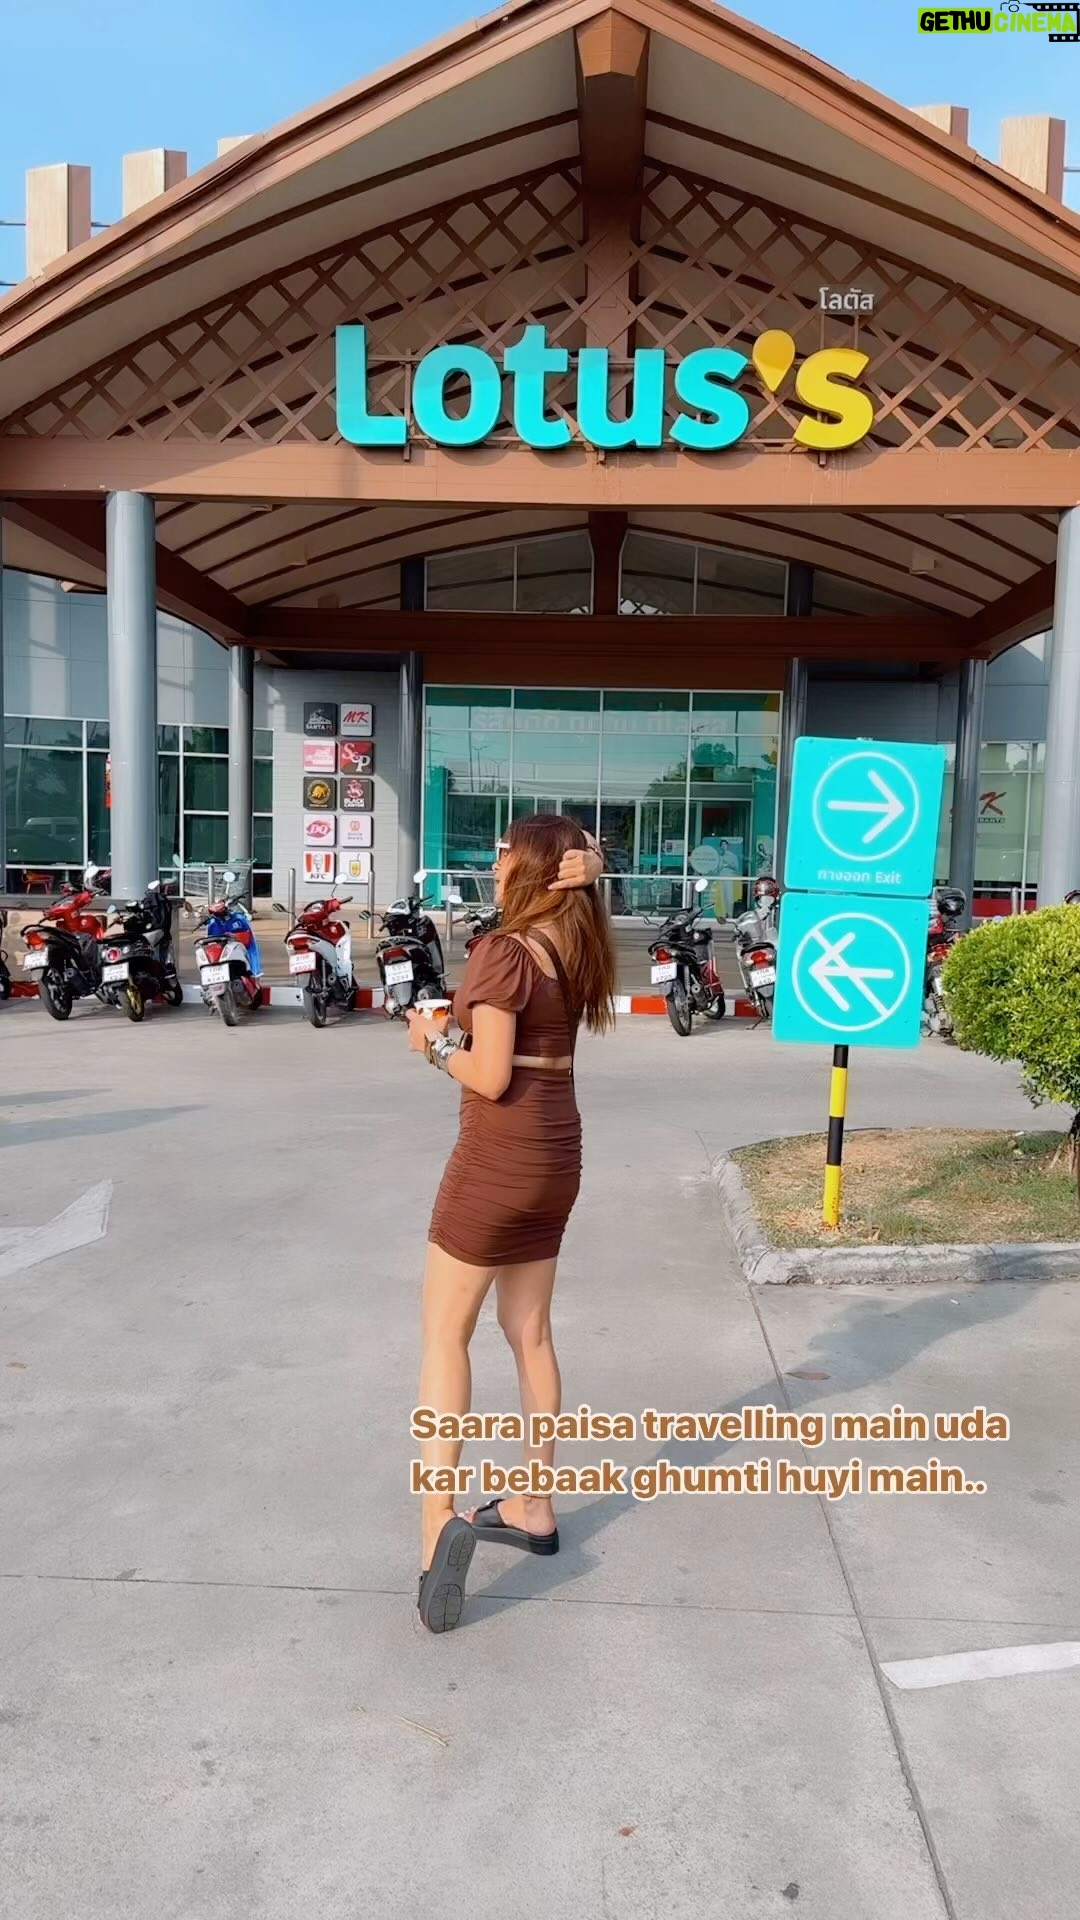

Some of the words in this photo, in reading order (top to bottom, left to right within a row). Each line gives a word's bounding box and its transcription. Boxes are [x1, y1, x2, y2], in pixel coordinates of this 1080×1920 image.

[818, 287, 875, 314] โลตัส
[334, 323, 875, 451] Lotus's
[343, 710, 369, 723] MK
[875, 871, 902, 885] Exit
